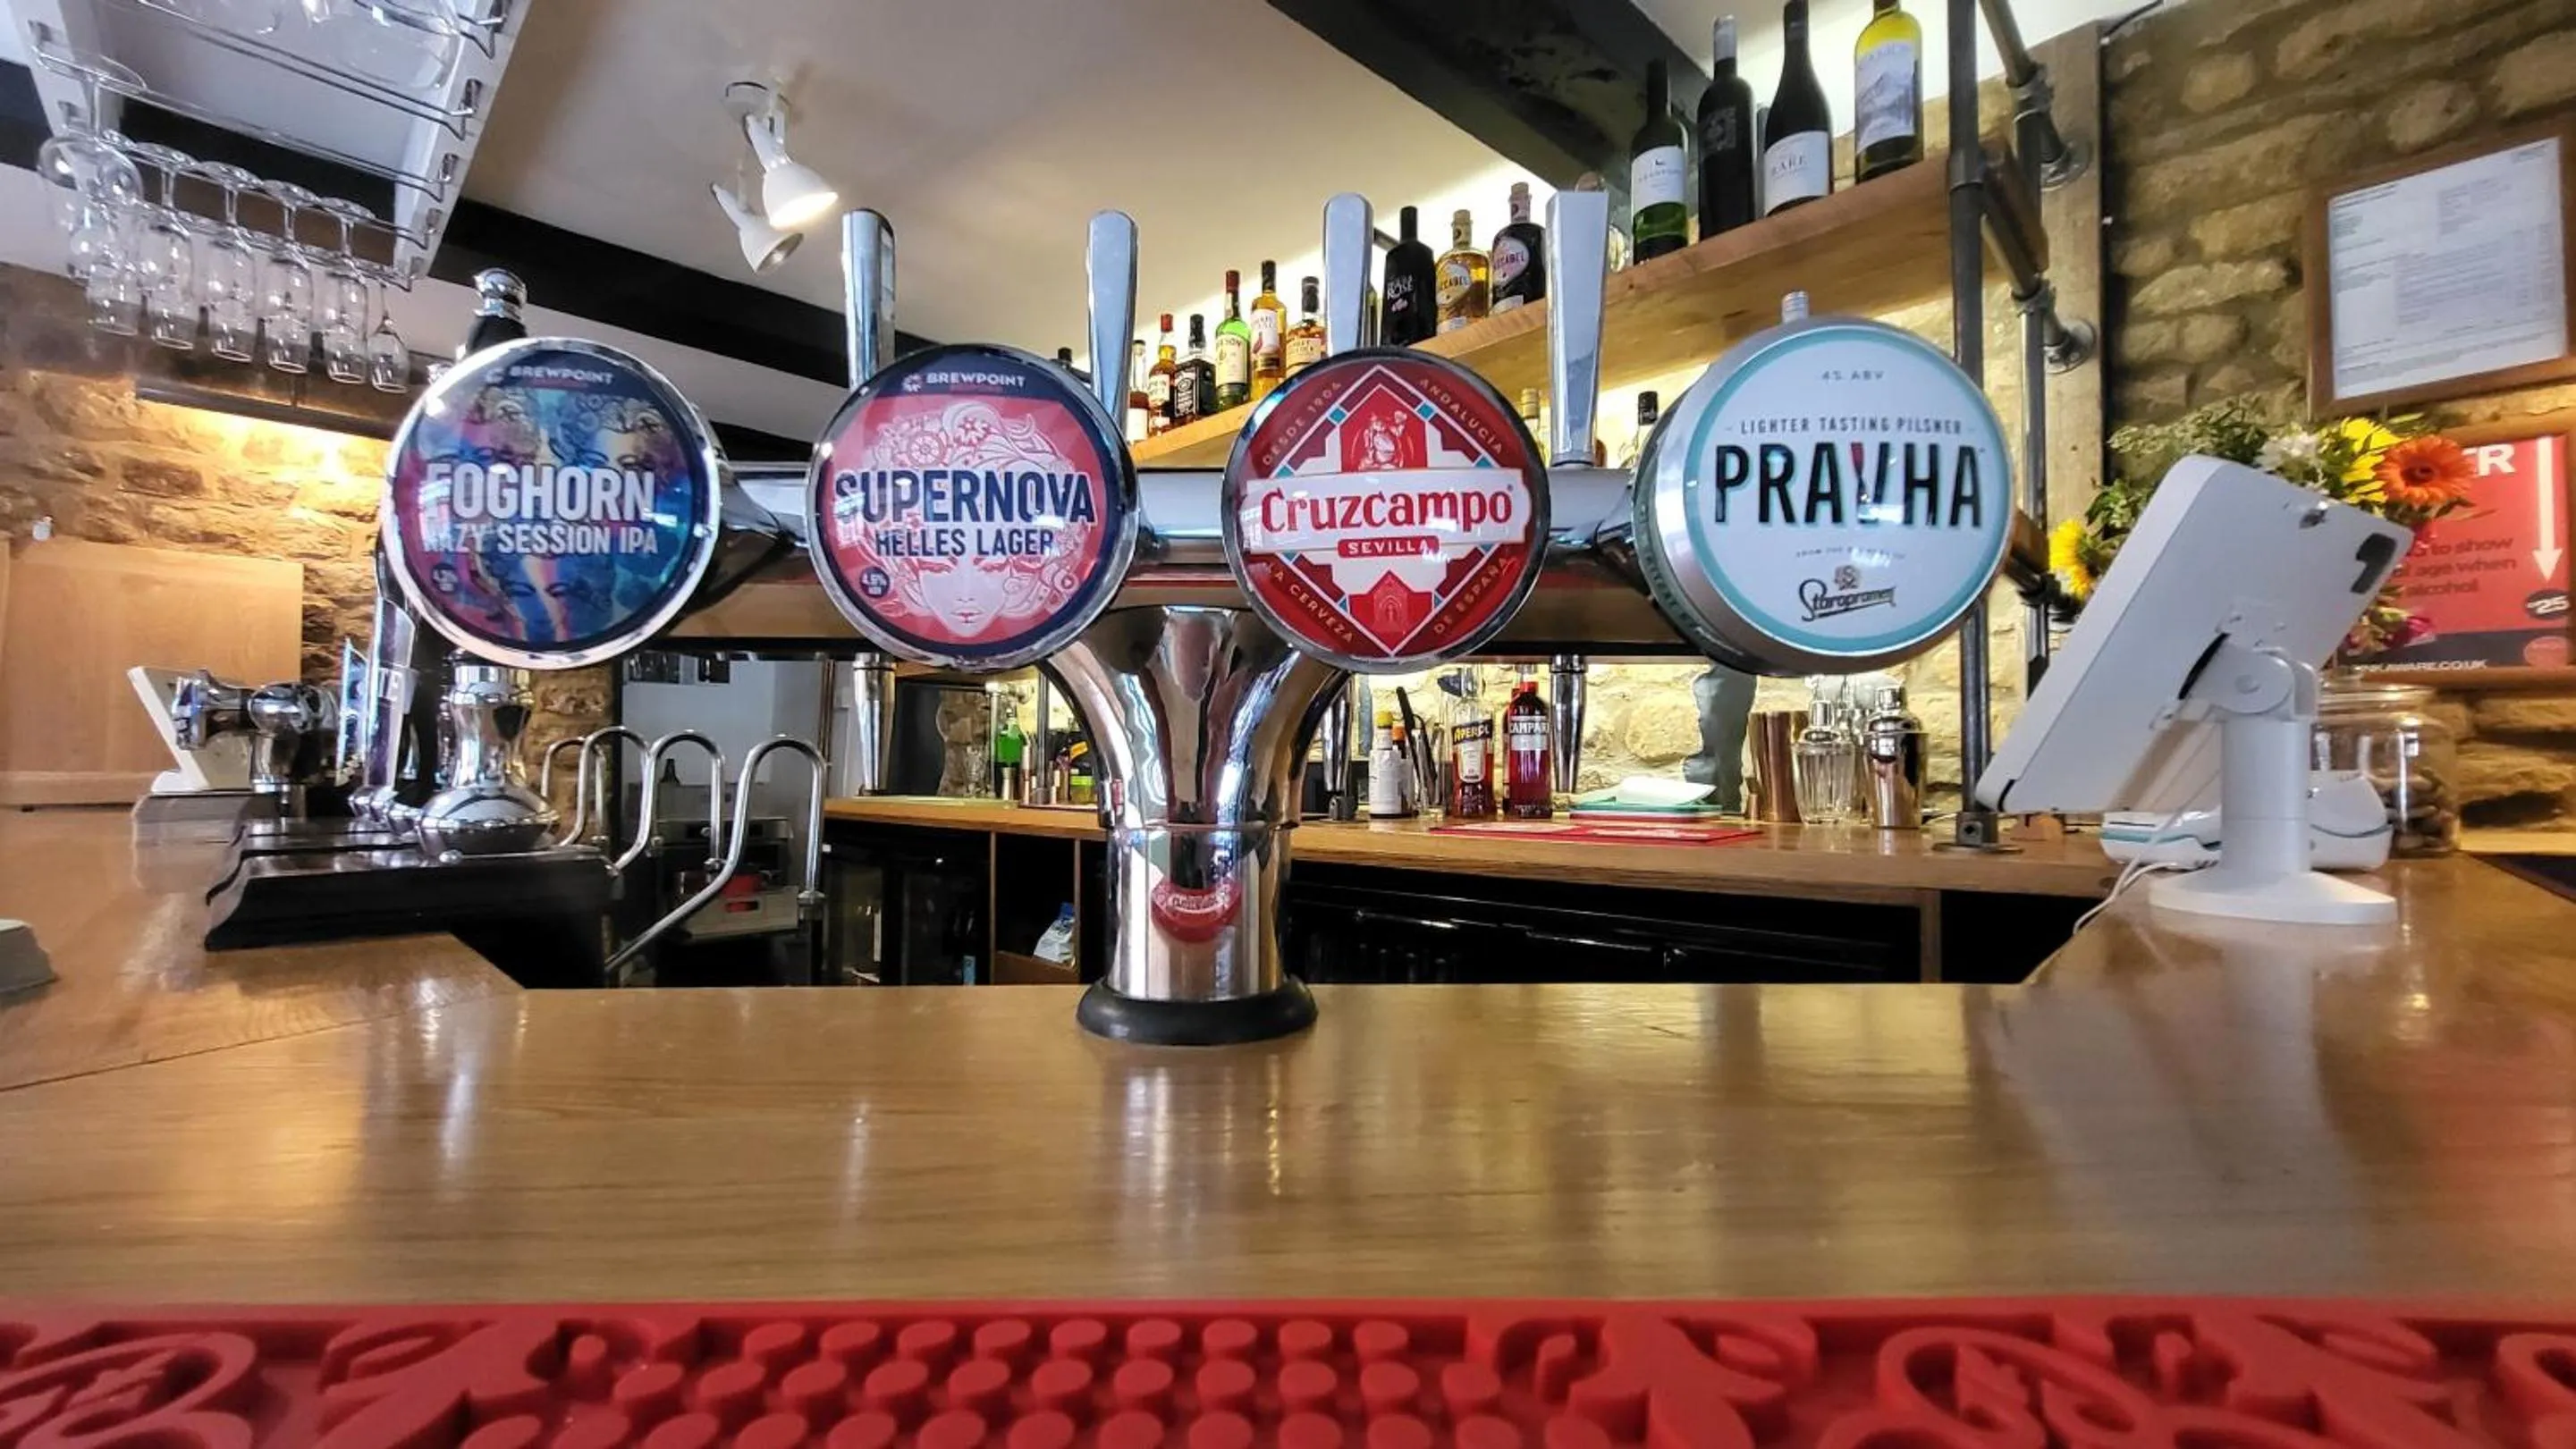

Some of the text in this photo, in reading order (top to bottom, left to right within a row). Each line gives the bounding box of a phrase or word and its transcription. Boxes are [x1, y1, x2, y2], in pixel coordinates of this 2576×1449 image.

[509, 366, 614, 384] BREWPOINT
[926, 372, 1026, 387] BREWPOINT
[1851, 369, 1885, 381] ABV
[1741, 416, 1962, 434] LIGHTER TASTING PILSNER
[1262, 417, 1305, 466] DESDE
[426, 463, 655, 522] FOGHORN
[1715, 442, 1982, 527] PRAVHA
[835, 469, 1096, 524] SUPERNOVA
[1261, 485, 1513, 534] Cruzcampo
[497, 522, 611, 555] SESSION
[619, 527, 658, 555] IPA
[876, 527, 1055, 557] HELLES LAGER
[1348, 538, 1429, 555] SEVILLA
[2431, 543, 2452, 556] to
[2455, 537, 2514, 553] show
[2415, 562, 2453, 578] age
[2456, 557, 2518, 573] when
[2405, 577, 2479, 596] alcohol
[1268, 562, 1353, 643] LA CERVEZA
[1798, 577, 1896, 622] Staropramen
[1454, 725, 1491, 741] APEROL
[1510, 721, 1550, 734] CAMPARI
